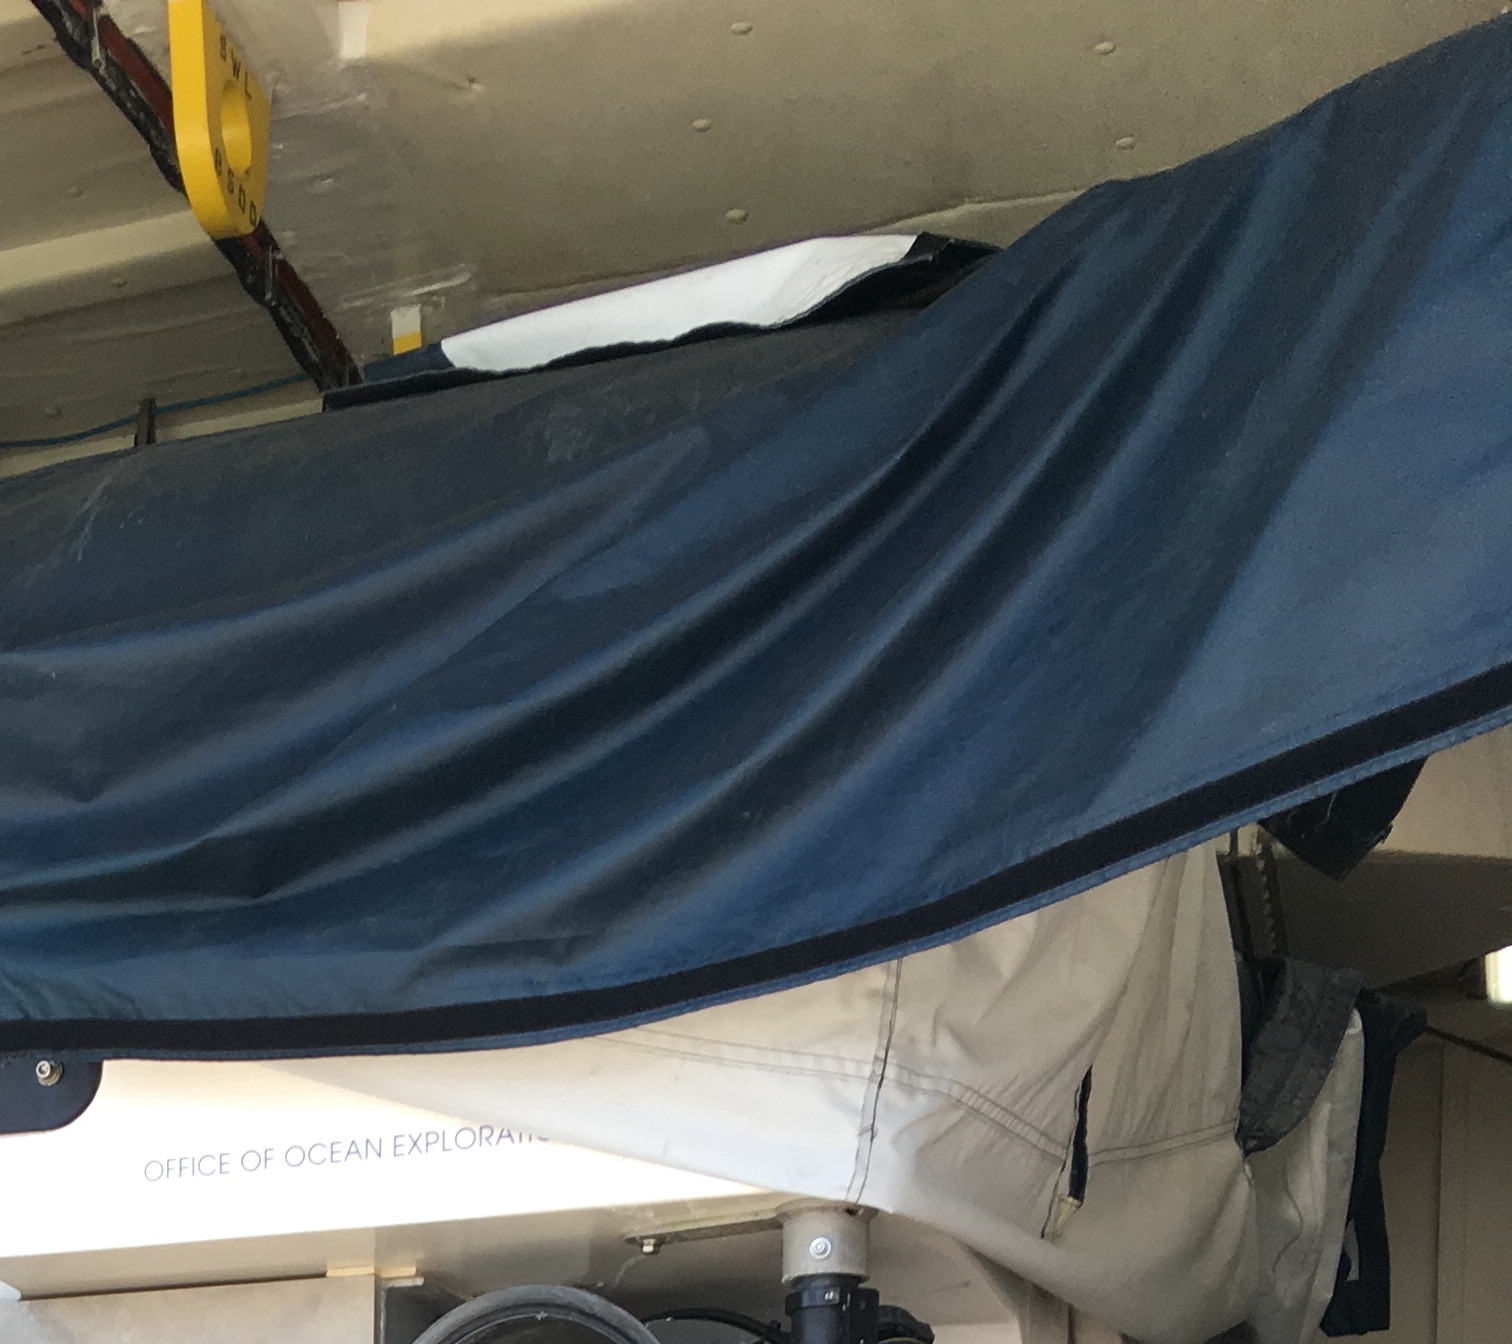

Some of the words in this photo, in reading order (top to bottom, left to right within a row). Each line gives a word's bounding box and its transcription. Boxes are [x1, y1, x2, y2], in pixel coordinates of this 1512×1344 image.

[219, 32, 252, 101] SWL
[143, 1152, 231, 1183] OFFICE
[240, 1148, 276, 1172] OF
[284, 1137, 384, 1168] OCEAN
